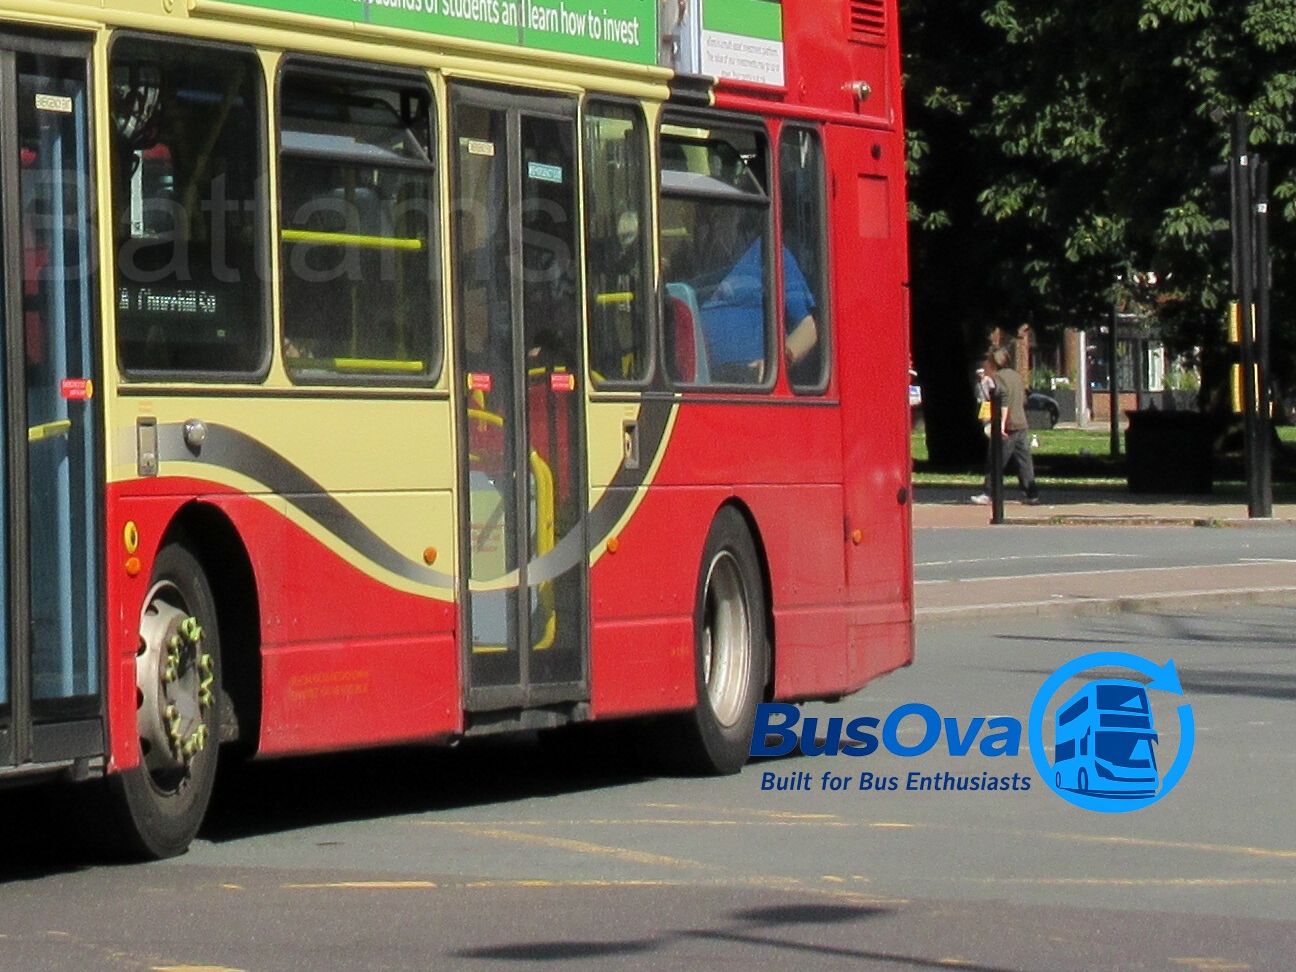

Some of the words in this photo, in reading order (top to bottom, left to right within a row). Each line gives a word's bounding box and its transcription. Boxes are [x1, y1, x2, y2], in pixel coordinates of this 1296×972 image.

[560, 1, 587, 37] how
[588, 9, 602, 40] to
[603, 8, 640, 46] invest
